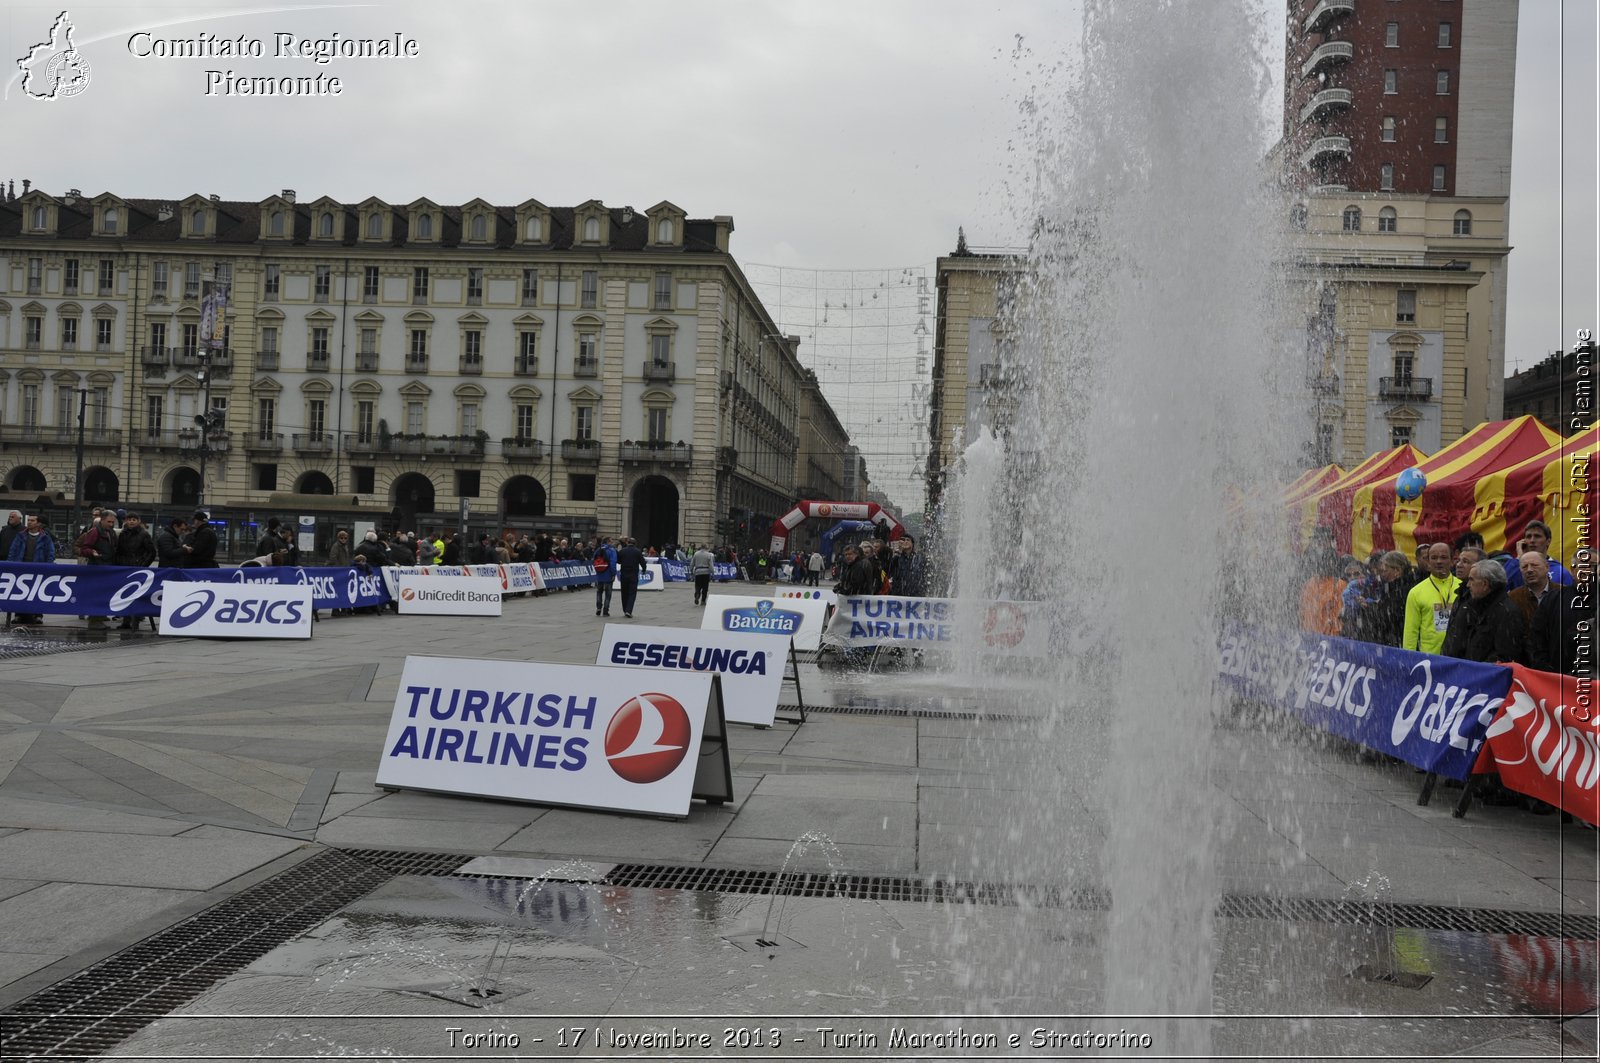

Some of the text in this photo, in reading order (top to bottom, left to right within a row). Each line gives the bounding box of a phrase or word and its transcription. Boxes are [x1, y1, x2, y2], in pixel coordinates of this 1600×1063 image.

[0, 572, 77, 603] asics
[418, 589, 500, 603] UniCredit Banca
[215, 599, 304, 624] asics
[729, 614, 794, 630] Bavaria
[847, 599, 951, 620] TURKIS
[849, 621, 952, 641] AIRLINE
[611, 641, 766, 675] ESSELUNGA
[1310, 658, 1376, 718] asics
[406, 686, 597, 730] TURKISH
[389, 725, 590, 772] AIRLINES
